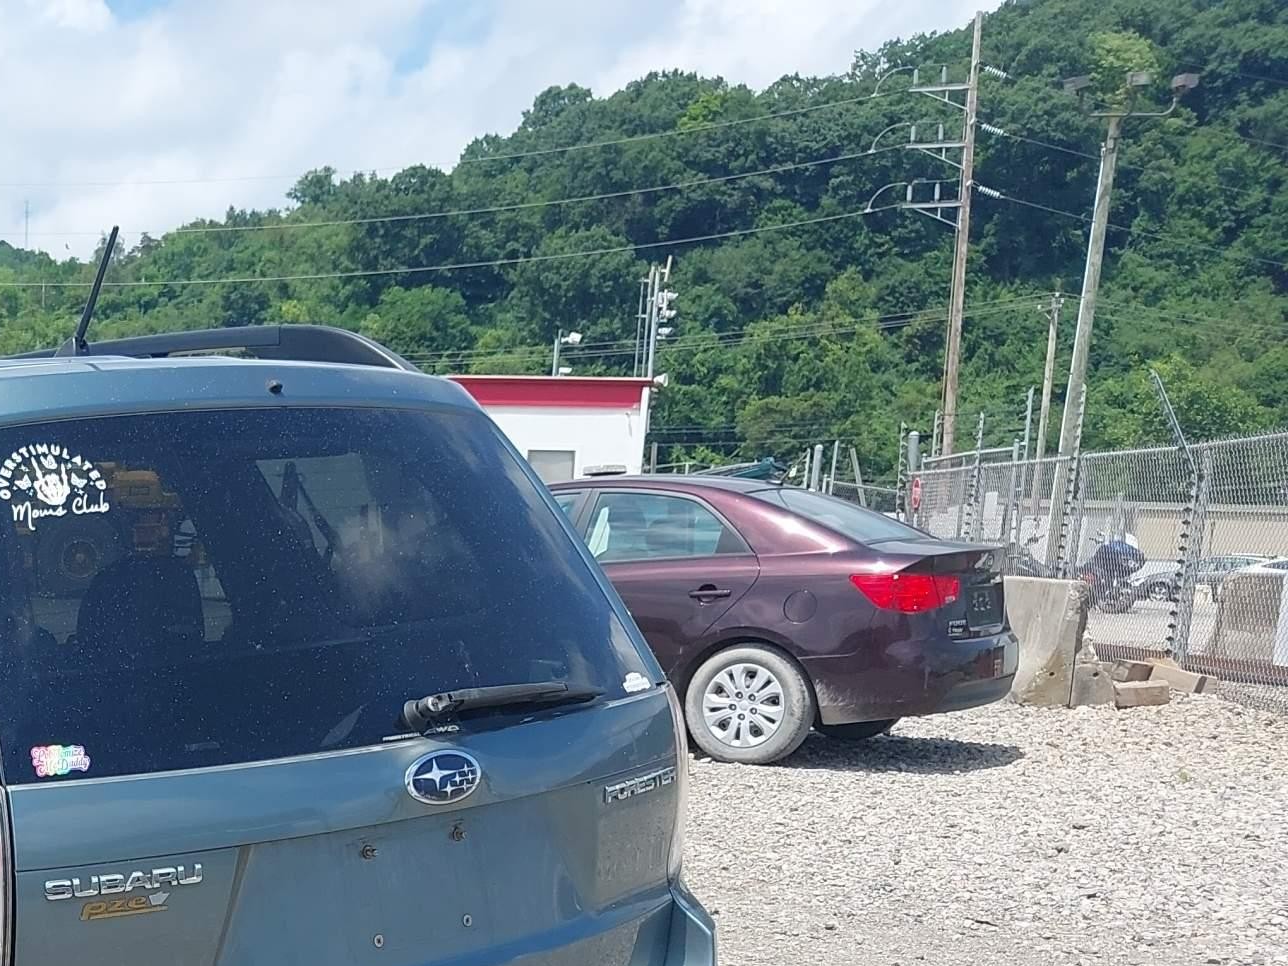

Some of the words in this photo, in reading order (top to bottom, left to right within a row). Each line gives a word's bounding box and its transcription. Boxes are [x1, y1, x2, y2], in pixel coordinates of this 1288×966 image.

[72, 491, 110, 515] Club
[423, 724, 460, 736] AWD
[604, 766, 677, 804] FORESTER
[44, 863, 203, 901] SUBARU
